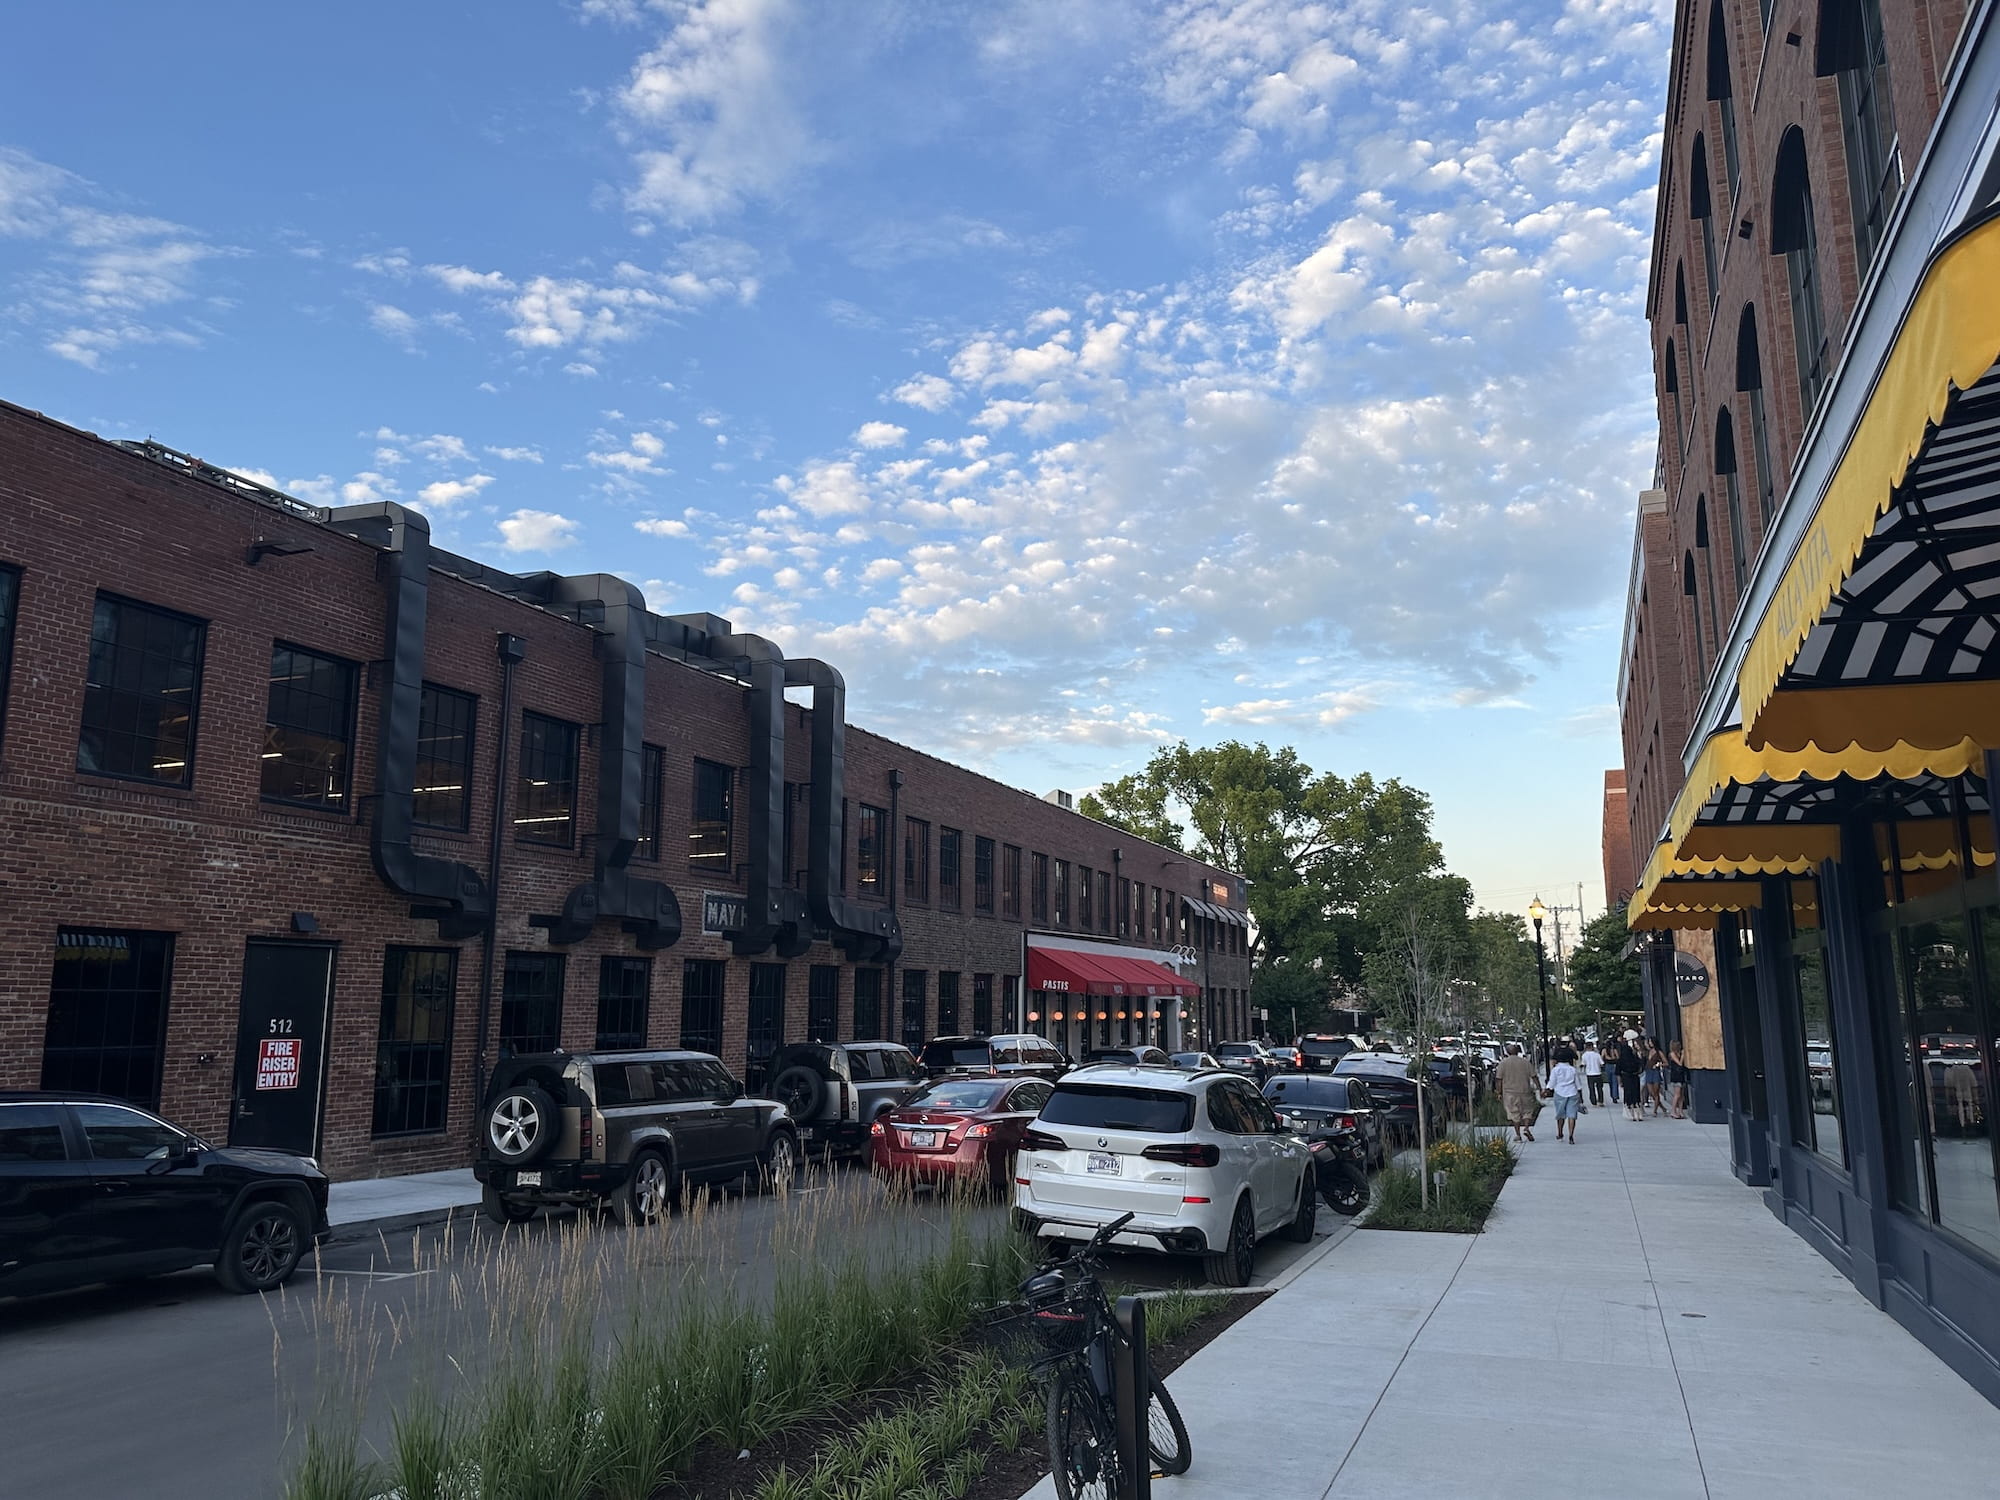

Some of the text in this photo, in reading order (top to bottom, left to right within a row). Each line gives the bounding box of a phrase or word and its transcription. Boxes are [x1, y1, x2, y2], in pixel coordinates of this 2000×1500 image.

[1799, 523, 1832, 598] VITA
[707, 902, 737, 926] MAY
[1042, 979, 1069, 991] PASTIS
[270, 1019, 292, 1033] 512
[267, 1042, 293, 1056] FIRE
[261, 1057, 296, 1071] RISER
[258, 1072, 296, 1087] ENTRY
